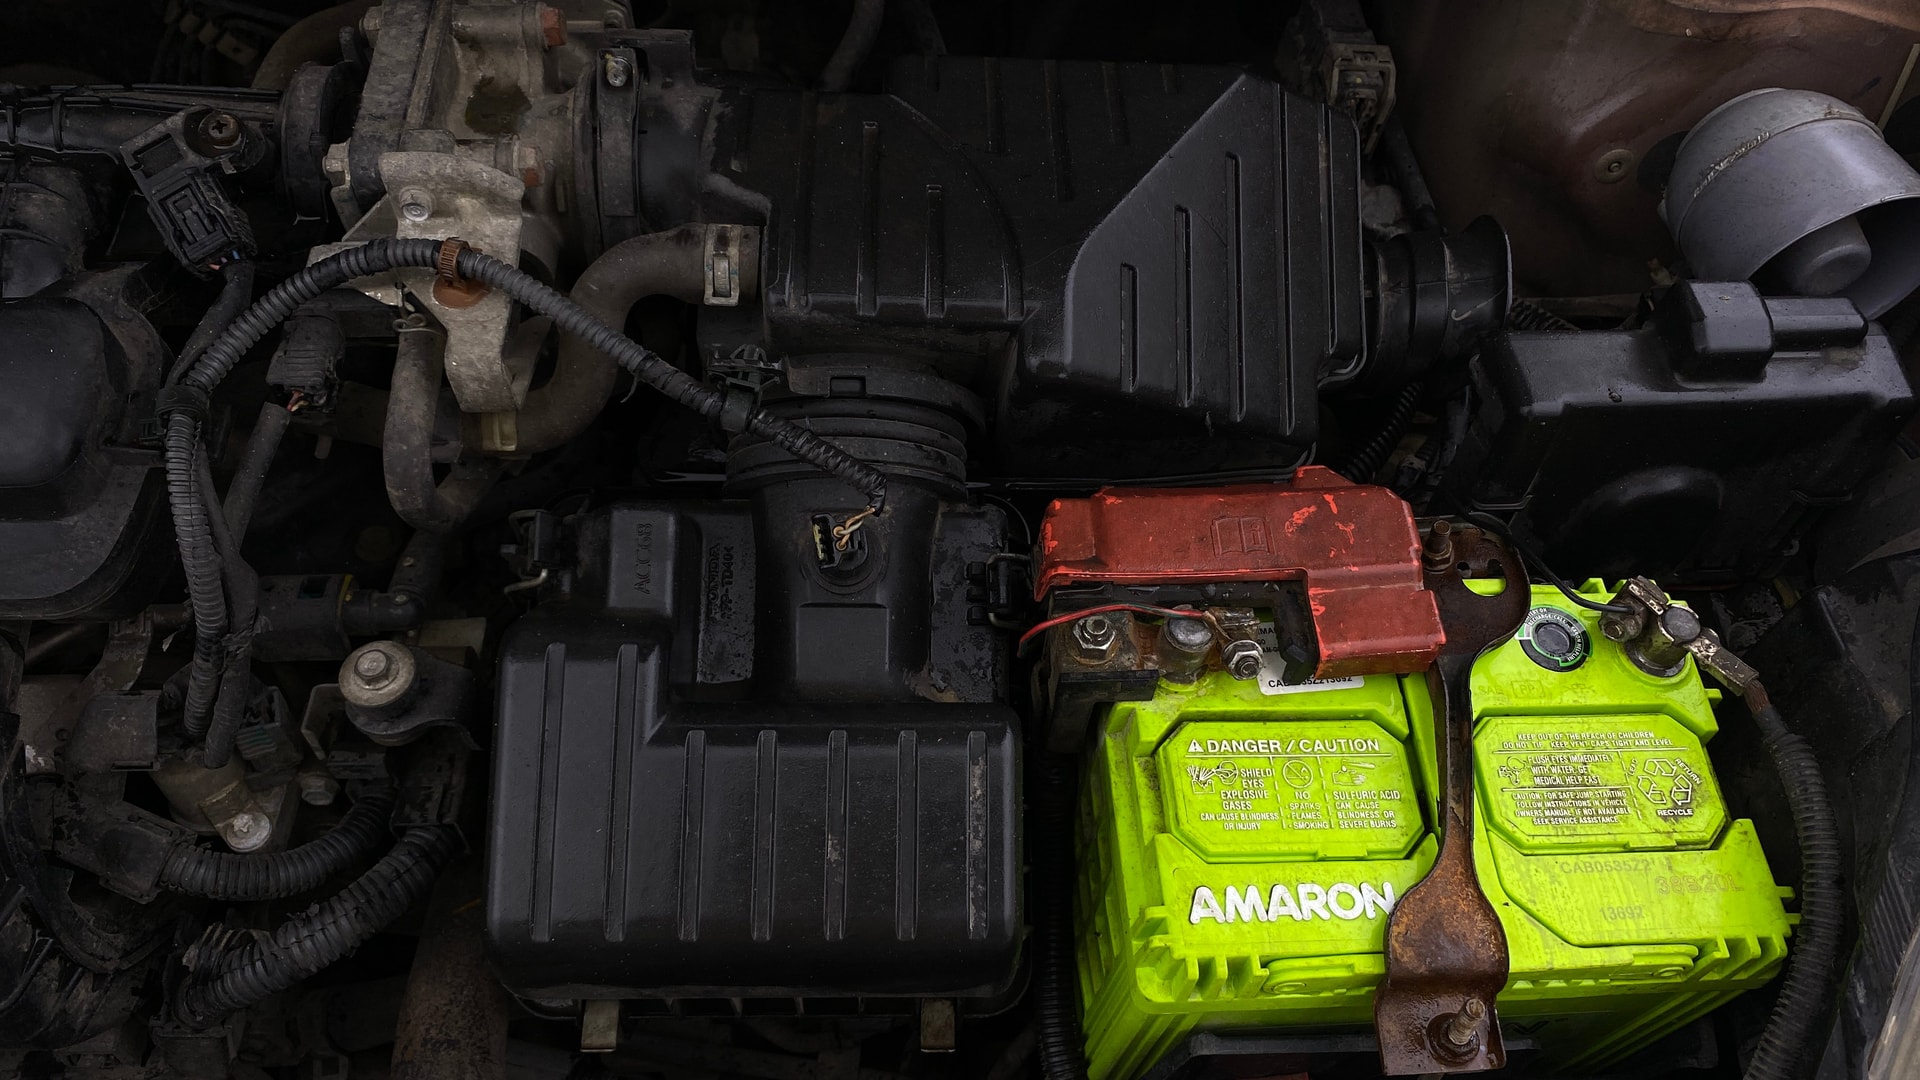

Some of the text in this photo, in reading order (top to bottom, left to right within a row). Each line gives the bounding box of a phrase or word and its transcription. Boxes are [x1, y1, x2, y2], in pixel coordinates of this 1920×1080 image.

[1207, 740, 1282, 752] DANGER
[1299, 739, 1380, 752] CAUTION
[1528, 754, 1614, 764] FLUSH EYES IMMEDIATELY
[1240, 768, 1272, 778] SHIELD
[1578, 766, 1590, 774] GET
[1675, 758, 1702, 784] RETURN
[1242, 780, 1264, 788] EYES
[1534, 776, 1600, 784] MEDICAL HELP FAST
[1221, 790, 1269, 799] EXPLOSIVE
[1295, 791, 1310, 800] NO
[1333, 790, 1400, 800] SULFURIC ACID
[1223, 801, 1252, 810] GASES
[1200, 812, 1278, 820] CAN CAUSE BLINDNESS
[1337, 811, 1380, 819] BLINDNESS
[1339, 820, 1396, 828] SEVERE BURNS
[1190, 882, 1396, 924] AMARON
